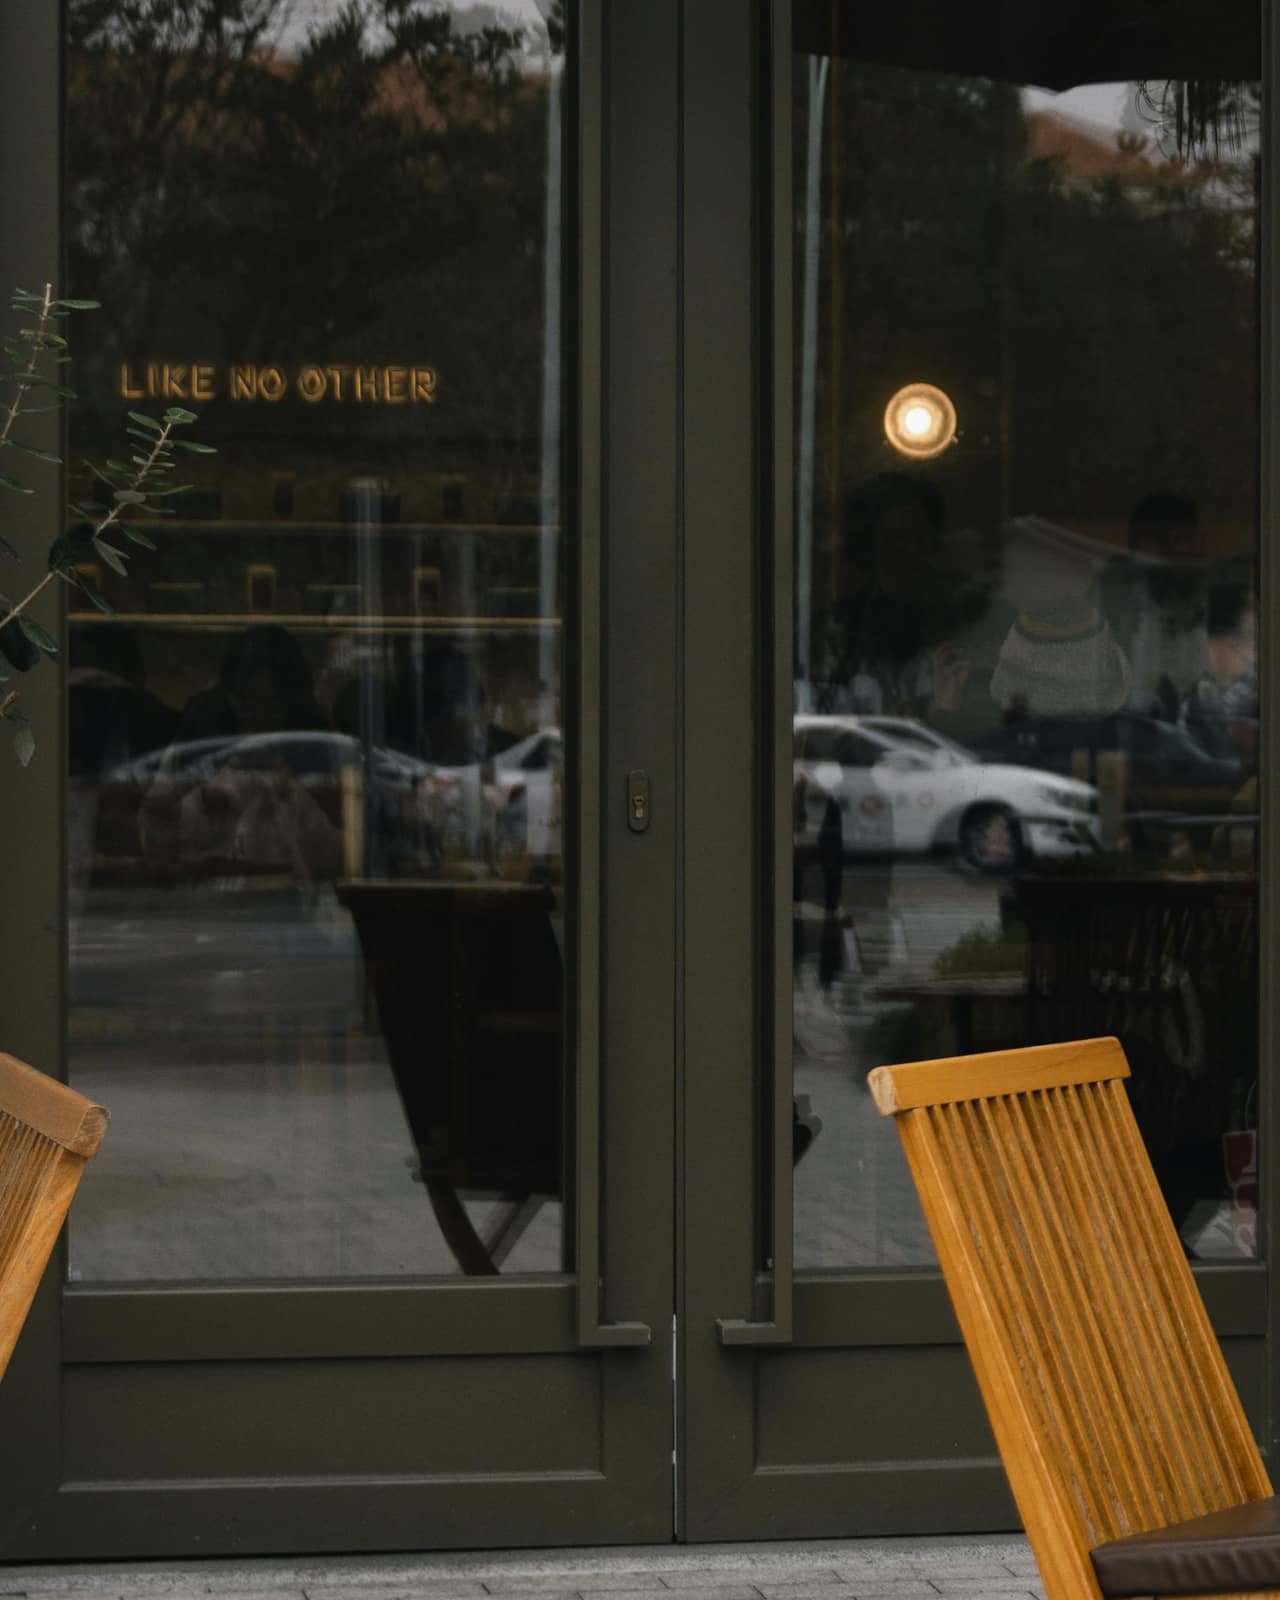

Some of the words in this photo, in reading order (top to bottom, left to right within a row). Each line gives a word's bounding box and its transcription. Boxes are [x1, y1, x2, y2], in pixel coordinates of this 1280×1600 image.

[119, 363, 215, 401] LIKE
[229, 365, 288, 402] NO
[296, 365, 439, 404] OTHER
